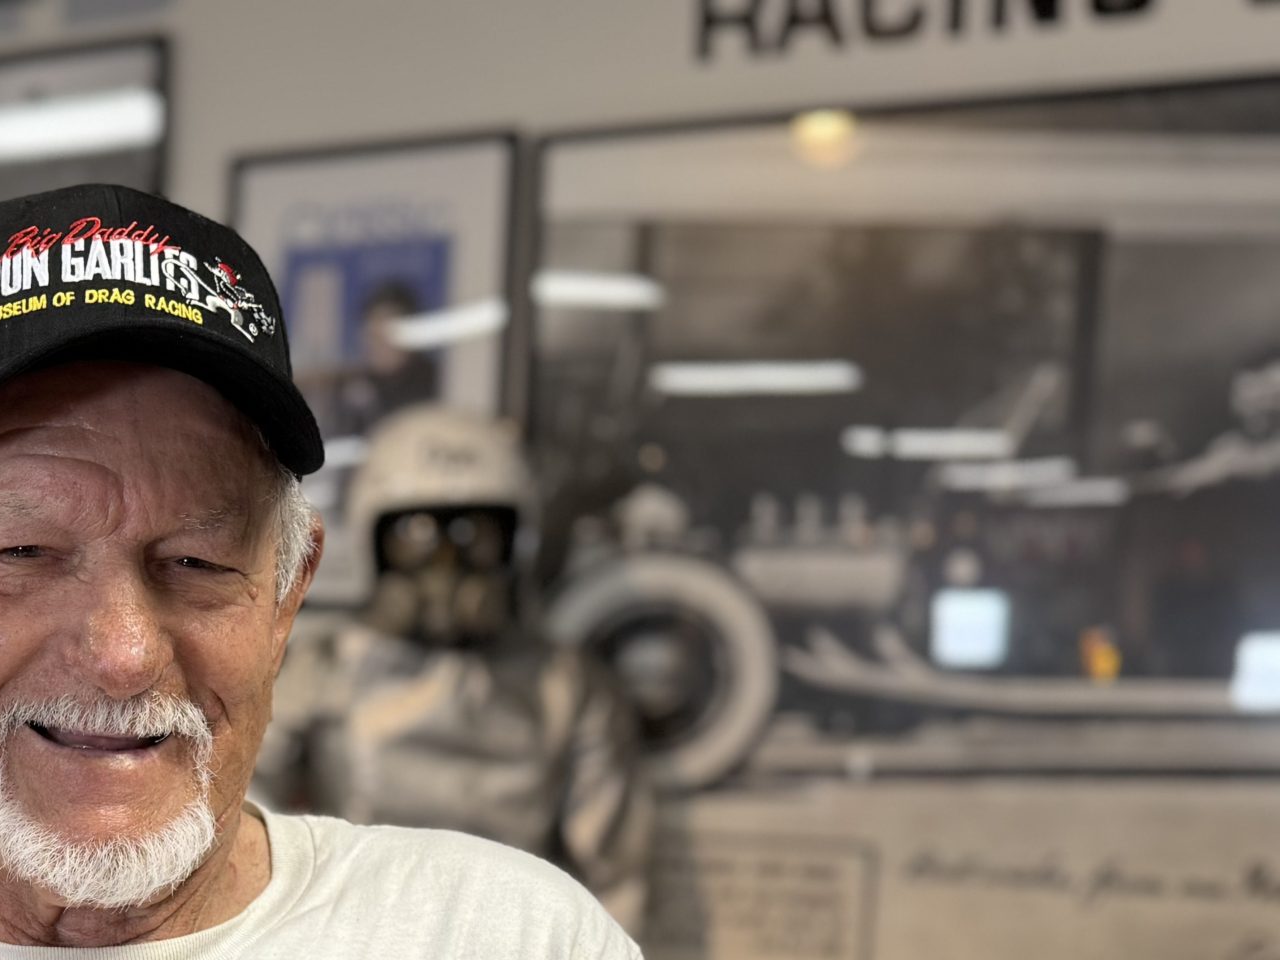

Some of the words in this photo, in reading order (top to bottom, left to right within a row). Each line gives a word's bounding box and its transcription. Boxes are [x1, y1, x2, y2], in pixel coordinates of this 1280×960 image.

[62, 216, 181, 256] Daddy
[61, 233, 200, 301] GARLITS
[53, 292, 75, 307] OF
[85, 288, 135, 304] DRAG
[145, 294, 204, 325] RACING
